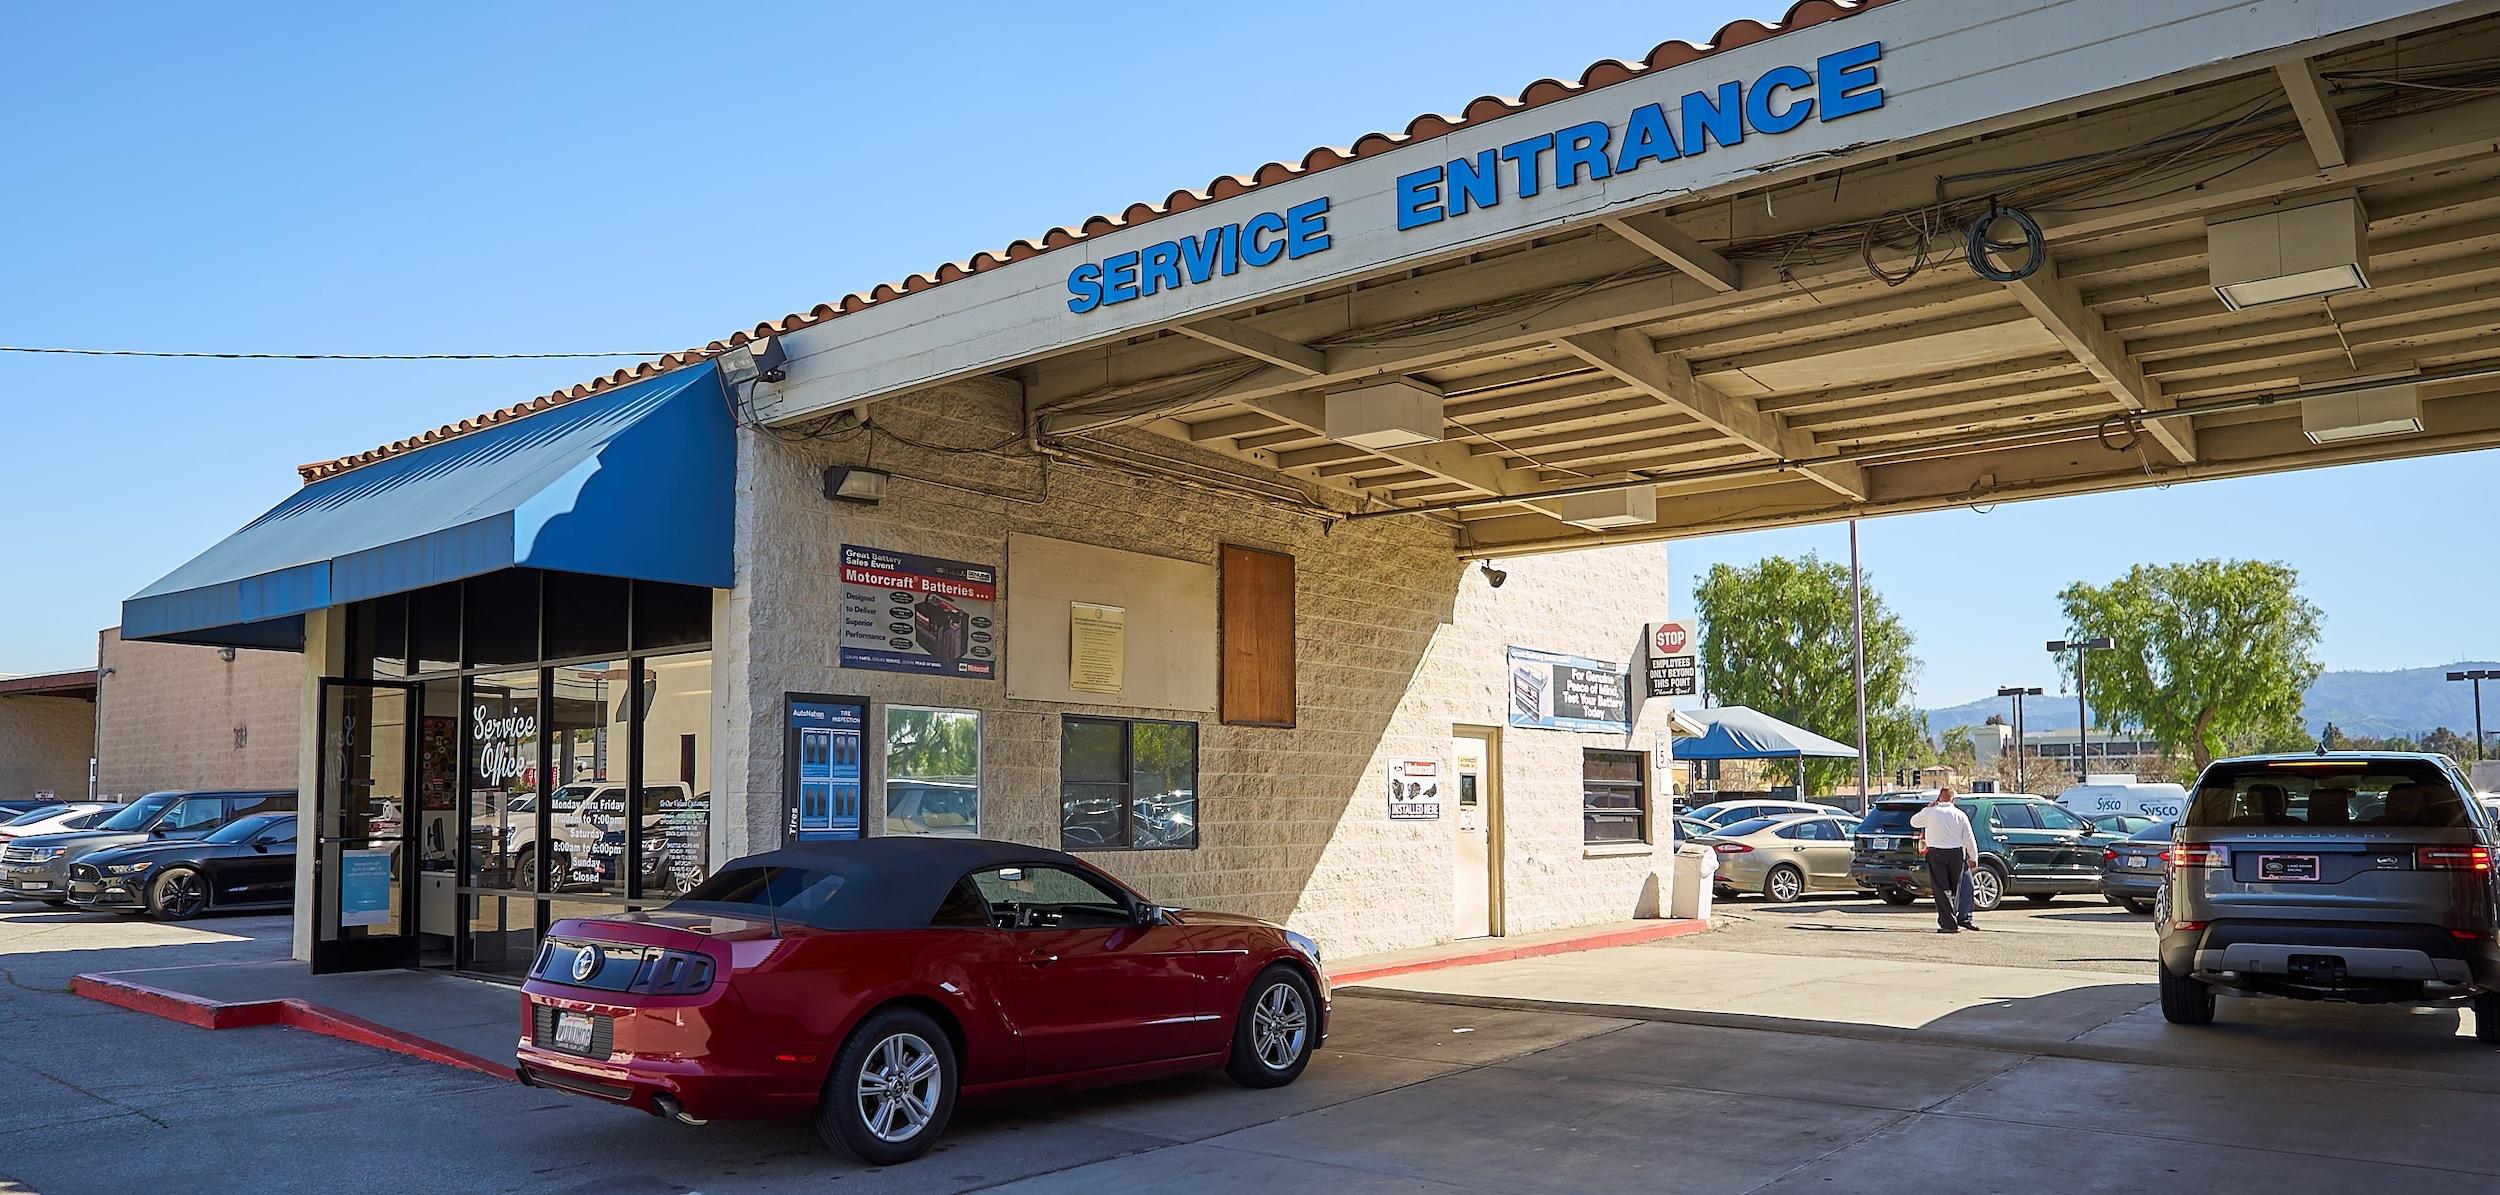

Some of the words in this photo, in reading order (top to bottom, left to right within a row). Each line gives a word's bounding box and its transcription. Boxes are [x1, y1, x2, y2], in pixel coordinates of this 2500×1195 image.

[1067, 196, 1331, 313] SERVICE
[1396, 40, 1884, 231] ENTRANCE
[846, 549, 870, 560] Great
[872, 553, 902, 565] Battery
[846, 557, 869, 567] Sales
[871, 560, 894, 570] Event
[846, 592, 875, 602] Designed
[854, 606, 876, 615] Deliver
[845, 618, 873, 627] Superior
[845, 631, 886, 641] Performance
[1656, 631, 1684, 646] STOP
[1652, 657, 1690, 669] EMPLOYEES
[1572, 668, 1585, 679] For
[1586, 671, 1614, 684] Genuine
[1650, 669, 1667, 679] ONLY
[1668, 667, 1694, 678] BEYOND
[1567, 680, 1589, 692] Peace
[1590, 683, 1598, 694] of
[1654, 679, 1669, 688] THIS
[1671, 677, 1690, 687] POINT
[1563, 691, 1579, 704] Test
[1580, 693, 1597, 705] Your
[1598, 696, 1623, 710] Battery
[793, 709, 825, 720] AutoNation
[1583, 706, 1605, 720] Today
[473, 705, 536, 740] Service
[480, 741, 527, 786] Office
[1660, 750, 1665, 764] 5
[551, 799, 580, 811] Monday
[582, 800, 598, 809] thru
[600, 799, 625, 812] Friday
[1391, 804, 1423, 815] INSTALLED
[1424, 804, 1439, 815] HERE
[555, 814, 580, 823] 7:00am
[583, 814, 592, 823] to
[593, 814, 622, 826] 7:00pm
[789, 807, 798, 835] Tires
[570, 828, 604, 841] Saturday
[553, 842, 580, 852] 8:00am
[583, 843, 591, 852] to
[592, 843, 622, 856] 6:00pm
[572, 857, 600, 869] Sunday
[573, 871, 599, 882] Closed
